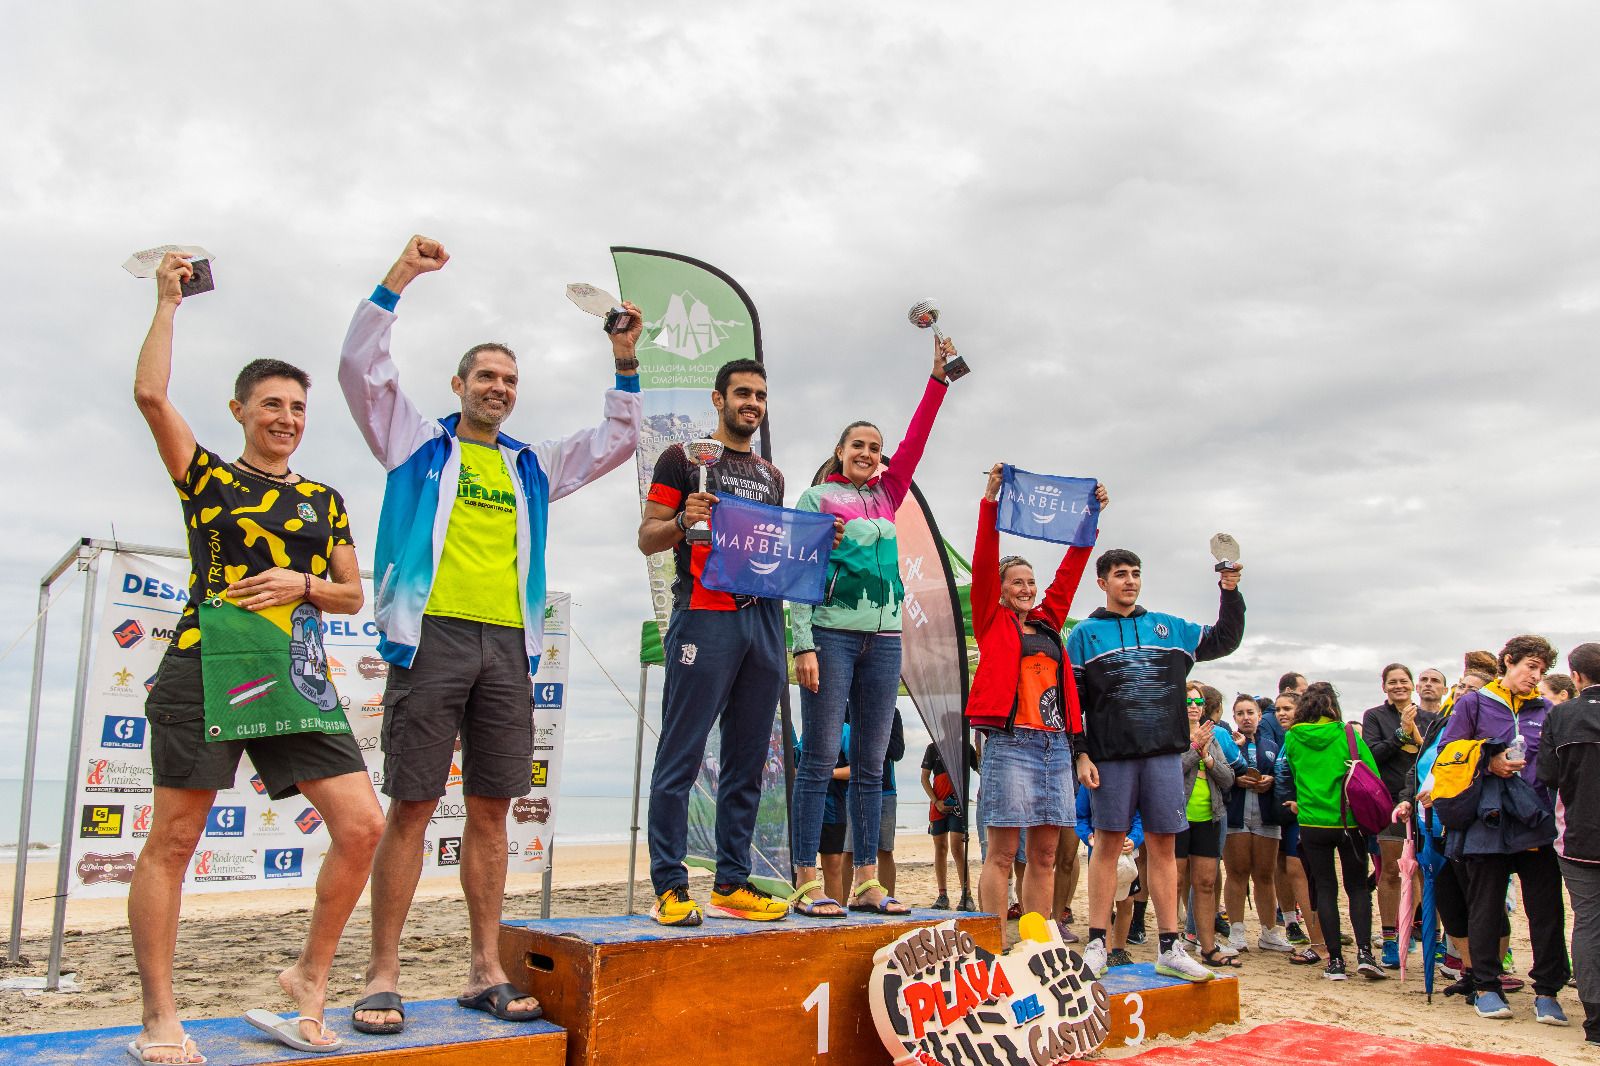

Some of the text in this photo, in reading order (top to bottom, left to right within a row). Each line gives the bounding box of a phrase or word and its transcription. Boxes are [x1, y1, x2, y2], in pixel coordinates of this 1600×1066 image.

[734, 487, 763, 501] MARBELLA
[1007, 489, 1092, 516] MARBELLA
[715, 530, 819, 564] MARBELLA
[237, 723, 267, 736] CLUB
[276, 720, 292, 731] DE
[903, 960, 1014, 1039] PLAYA
[1011, 993, 1045, 1025] DEL
[802, 982, 830, 1055] 1
[1123, 993, 1146, 1046] 3
